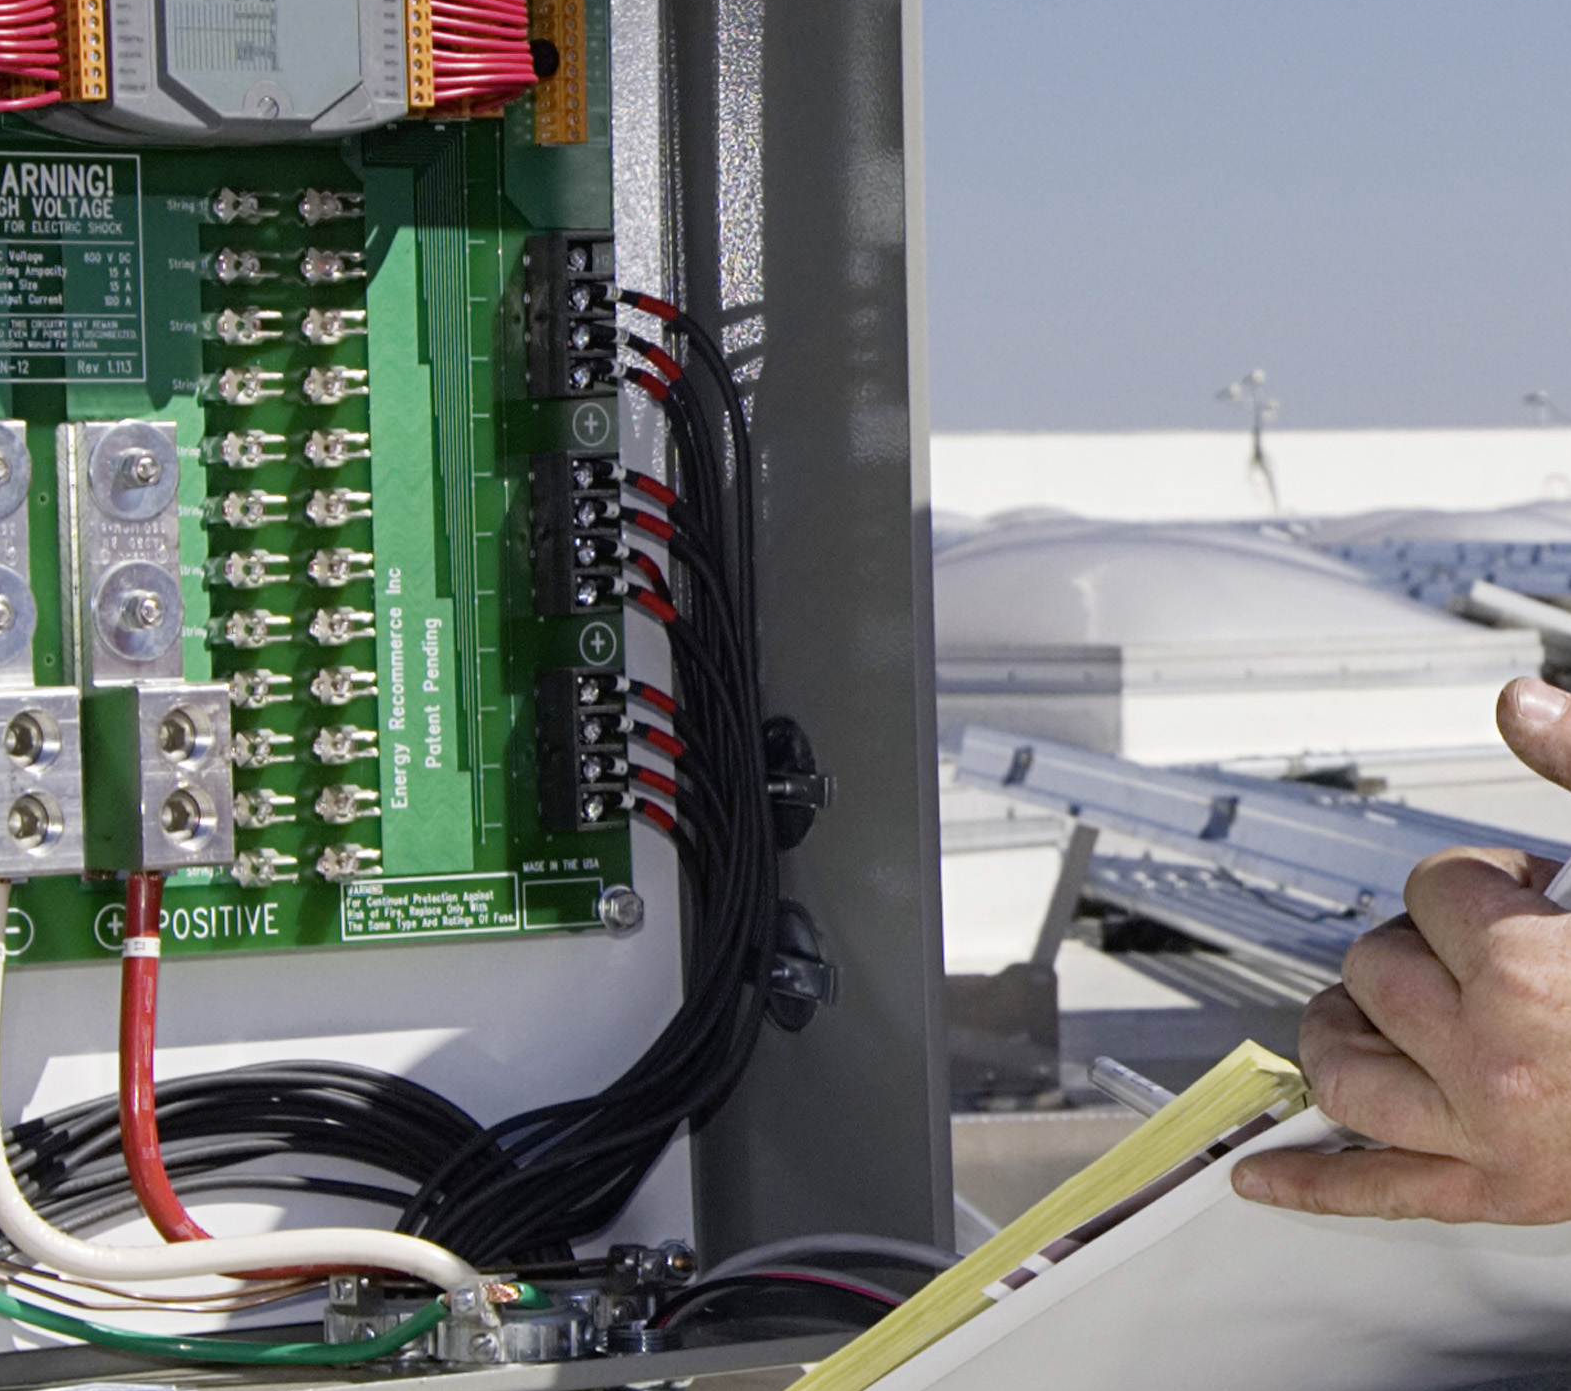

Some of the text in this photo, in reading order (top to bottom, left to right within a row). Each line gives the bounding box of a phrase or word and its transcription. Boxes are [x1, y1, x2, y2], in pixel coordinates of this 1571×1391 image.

[31, 197, 114, 219] VOLTAGE
[166, 199, 197, 212] String
[3, 220, 26, 233] FOR
[31, 220, 82, 234] ELECTRIC
[87, 221, 123, 235] SHOCK
[8, 250, 44, 263] Voltage
[118, 252, 132, 264] DC
[168, 258, 199, 271] String
[24, 265, 68, 279] Ampacity
[124, 267, 132, 279] A
[18, 279, 38, 291] Size
[124, 282, 132, 292] A
[27, 294, 64, 306] Current
[125, 296, 132, 307] A
[169, 320, 198, 334] String
[77, 361, 99, 374] Rev
[384, 567, 411, 809] Energy Recommerce Inc
[421, 617, 443, 769] Patent Pending
[522, 858, 600, 874] MADE IN THE USA
[346, 890, 494, 909] For Continued Protection Against
[347, 908, 365, 921] Risk
[409, 903, 442, 918] Replace
[446, 902, 465, 918] Only
[469, 901, 488, 914] With
[347, 920, 363, 933] The
[396, 917, 417, 933] Type
[421, 916, 438, 929] And
[442, 914, 474, 929] Ratings
[478, 912, 490, 925] Of
[493, 910, 516, 925] Fuse.
